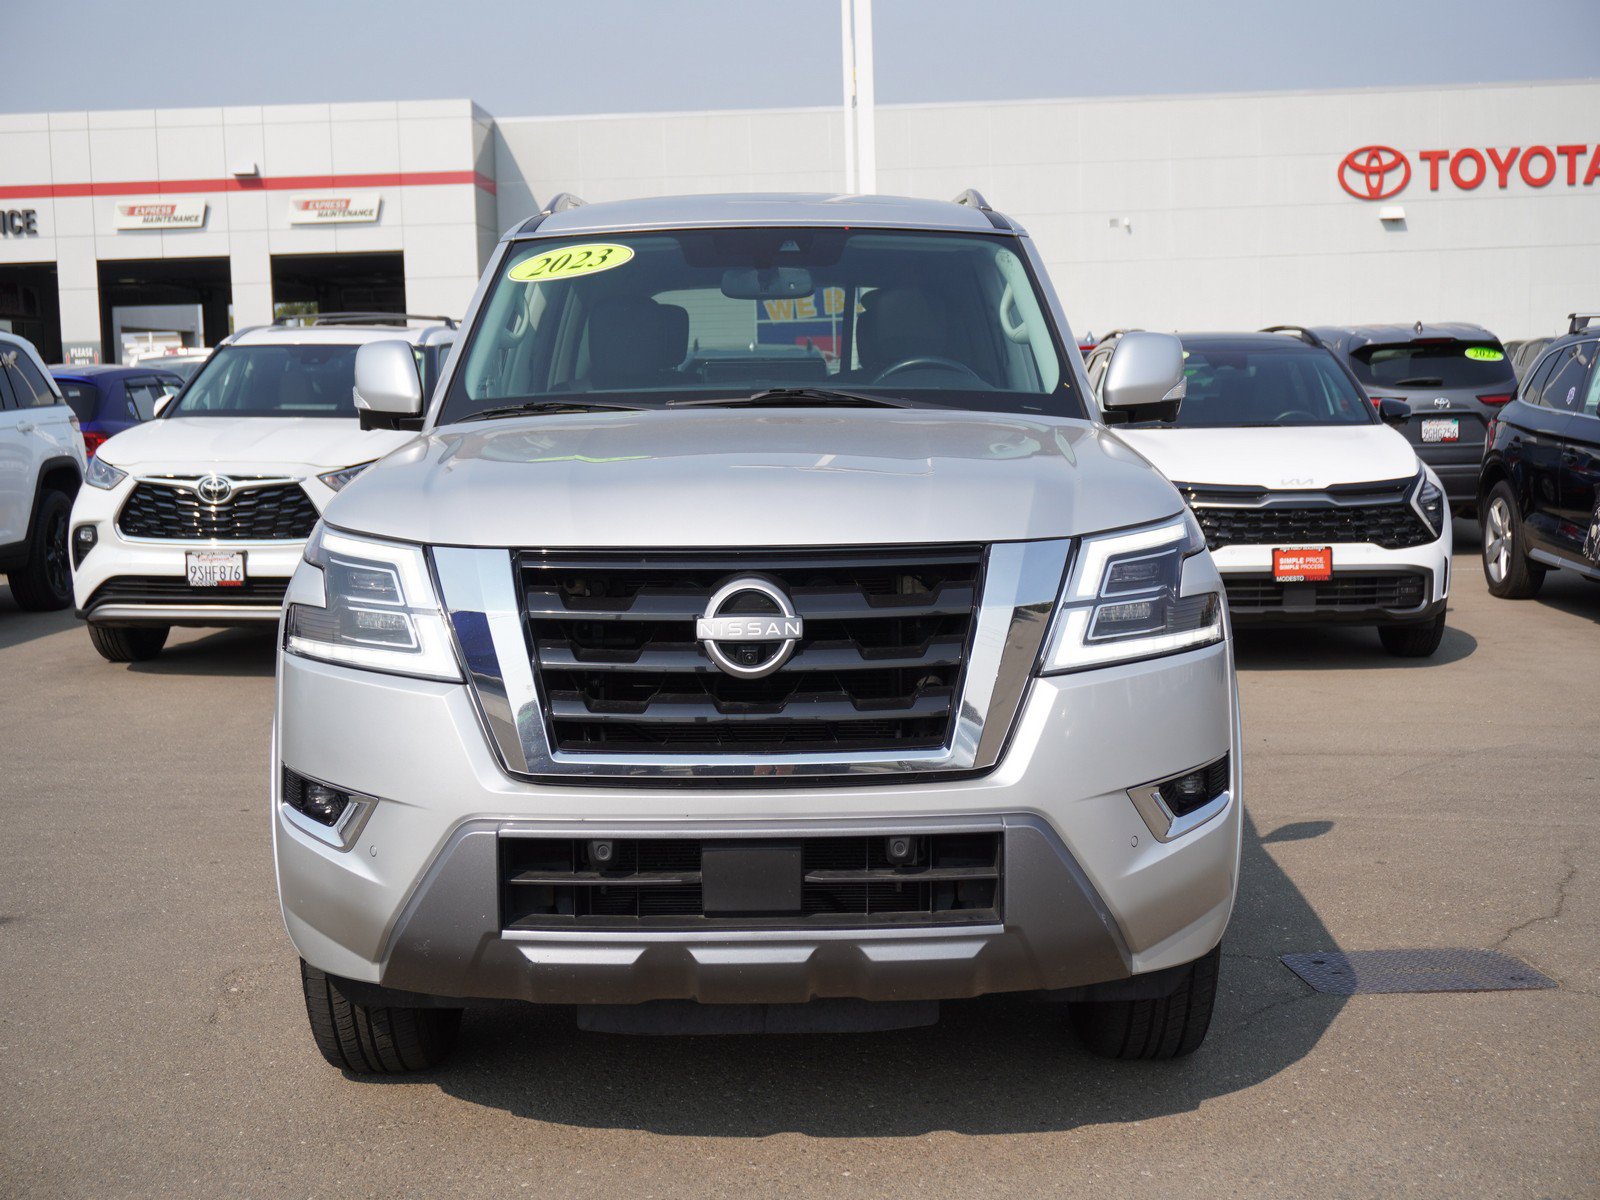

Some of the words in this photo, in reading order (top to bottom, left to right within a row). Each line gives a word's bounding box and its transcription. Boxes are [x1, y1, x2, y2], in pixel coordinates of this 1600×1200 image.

[134, 204, 173, 215] EXPRESS
[308, 199, 347, 210] EXPRESS
[317, 208, 375, 218] MAINTENANCE
[142, 214, 199, 224] MAINTENANCE
[527, 248, 613, 277] 2023
[763, 294, 817, 321] WE
[70, 347, 93, 358] PLEASE
[190, 565, 241, 581] 9SHF876
[700, 621, 800, 636] NISSAN
